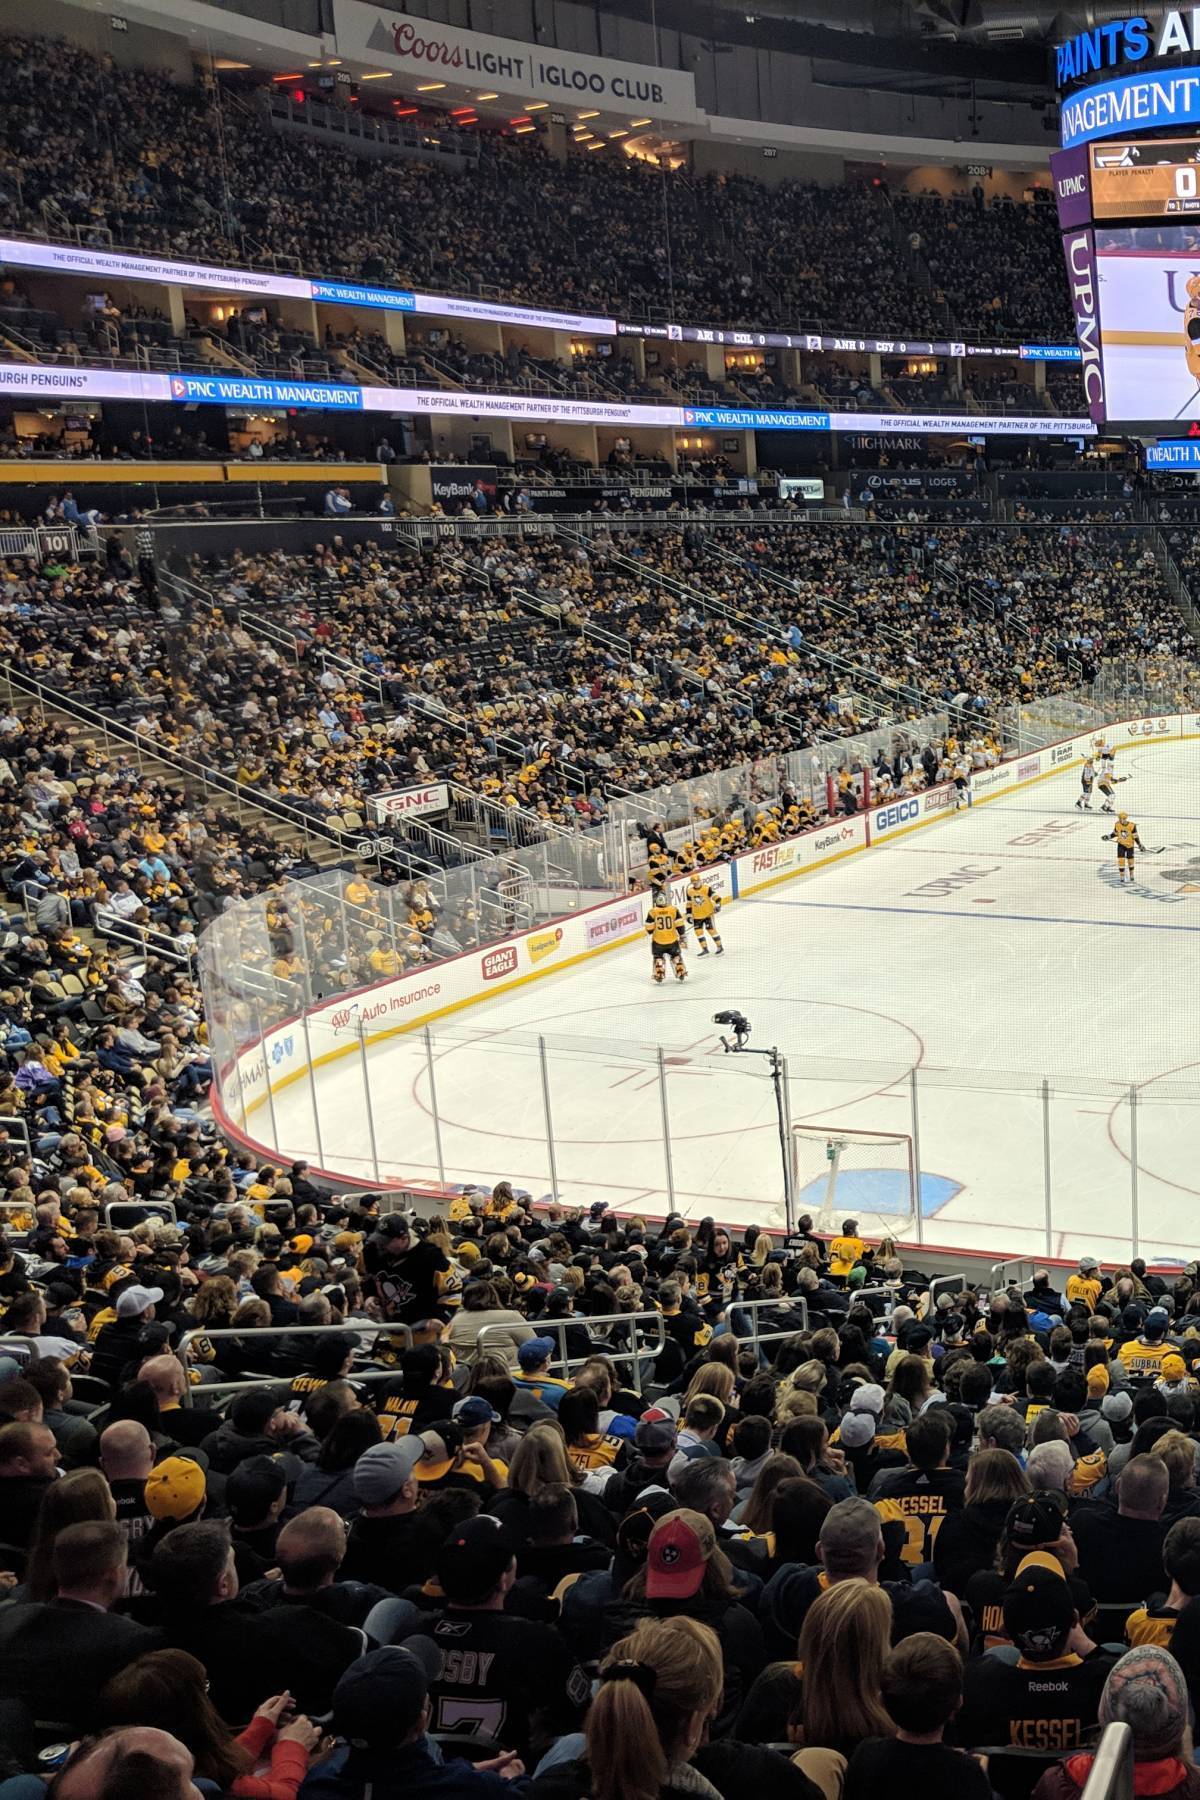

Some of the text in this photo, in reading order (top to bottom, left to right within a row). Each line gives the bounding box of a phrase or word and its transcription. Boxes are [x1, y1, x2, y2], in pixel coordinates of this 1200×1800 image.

[393, 23, 524, 79] Coors LIGHT
[1057, 17, 1149, 87] PAINTS
[540, 65, 663, 103] IGLOO CLUB
[1058, 175, 1086, 197] UPMC
[1175, 167, 1197, 198] 0
[320, 286, 414, 307] PNC WEALTH MANAGEMENT
[1069, 237, 1103, 404] UPMC
[697, 330, 753, 345] ARI COL
[834, 340, 894, 352] ANH CGY
[1029, 348, 1069, 357] PNC WEALTH
[187, 381, 359, 405] PNC WEALTH MANAGEMENT
[417, 397, 604, 416] THE OFFICIAL WEALTH MANAGEMENT PARTNER OF THE PITTSBURGH
[695, 412, 827, 426] PNC WEALTH MANAGEMENT
[923, 420, 950, 428] WEALTH
[951, 421, 997, 429] MANAGEMENT
[1053, 423, 1095, 431] PITTSBURGH
[852, 437, 921, 451] HIGHMARK
[1151, 446, 1189, 461] WEALTH
[433, 483, 474, 497] KeyBank
[929, 478, 957, 486] LOGES
[629, 488, 671, 498] PENGUINS
[381, 523, 392, 532] 102
[440, 524, 455, 536] 103
[45, 535, 69, 552] 101
[1057, 747, 1072, 756] RAM
[387, 791, 440, 811] GNC
[876, 799, 919, 831] GEICO
[361, 844, 372, 855] 66
[815, 832, 840, 851] KeyBank
[902, 864, 1001, 897] UPMC
[618, 911, 638, 928] PIZZA
[657, 917, 673, 930] 30
[485, 949, 514, 967] GIANT
[486, 957, 515, 976] EAGLE
[362, 983, 441, 1022] Auto Insurance
[384, 1395, 420, 1416] MALKIN
[1028, 1681, 1069, 1692] Reebok
[1010, 1719, 1082, 1750] KESSEL
